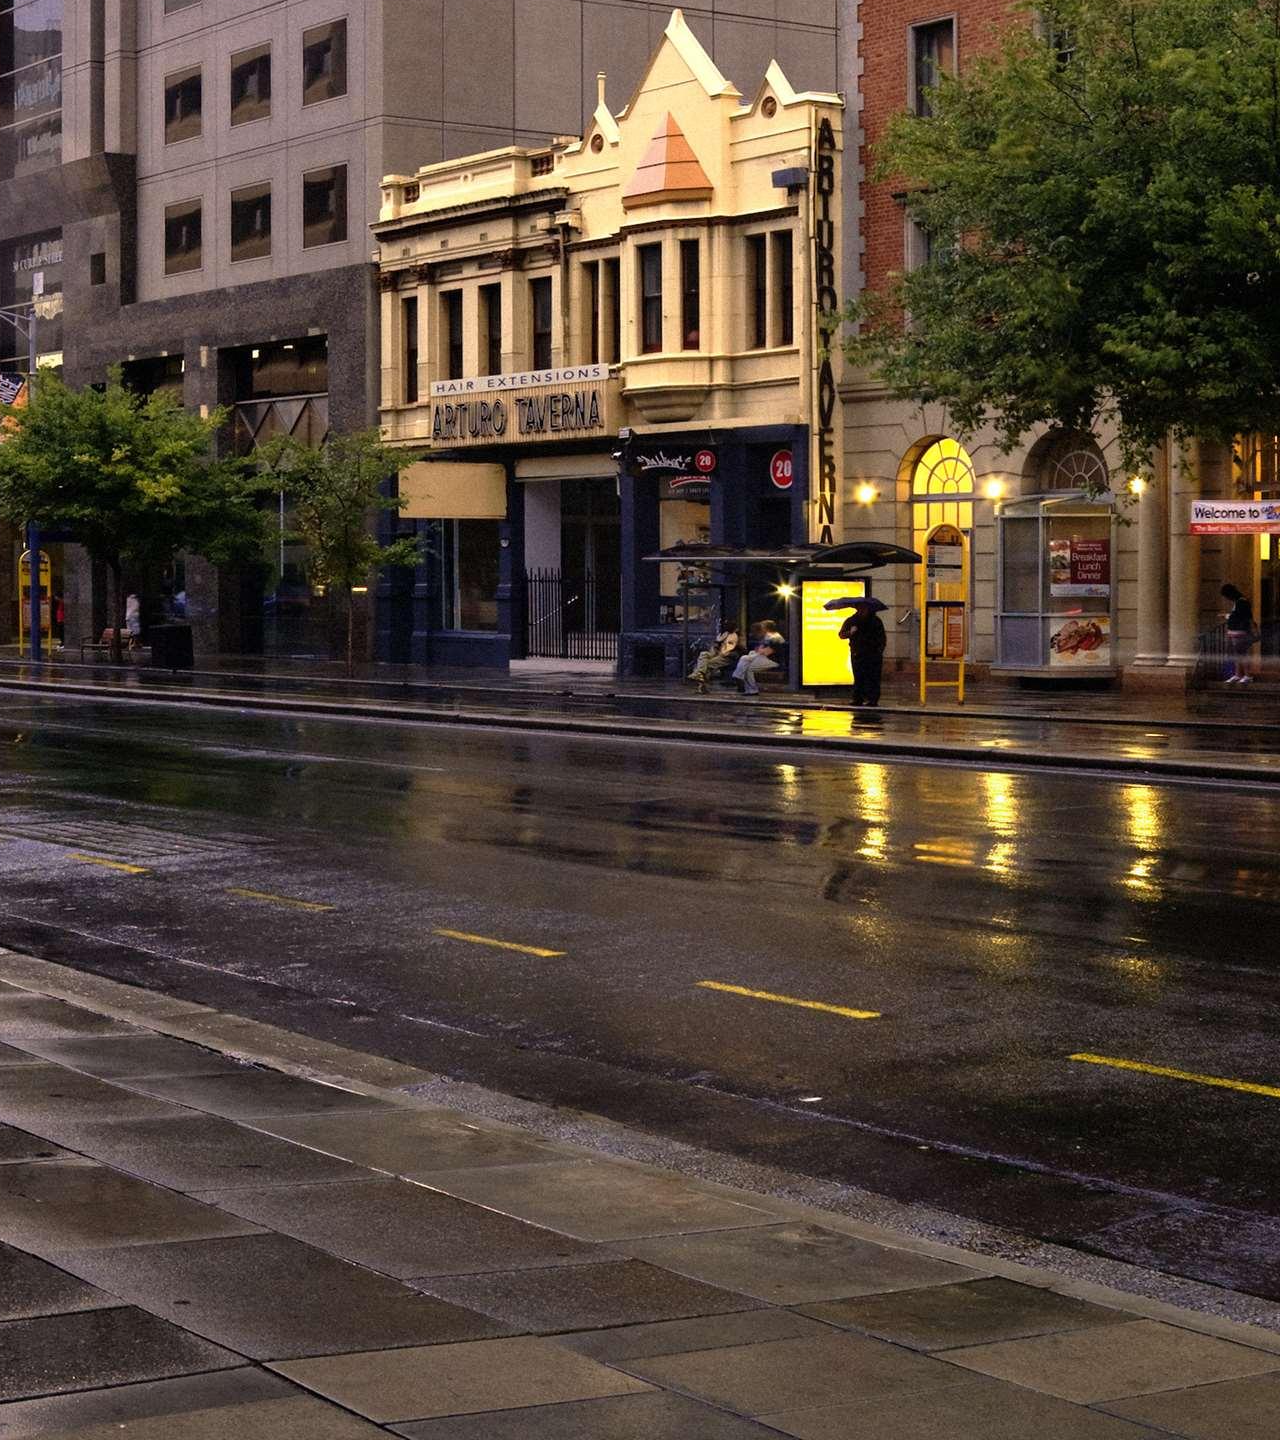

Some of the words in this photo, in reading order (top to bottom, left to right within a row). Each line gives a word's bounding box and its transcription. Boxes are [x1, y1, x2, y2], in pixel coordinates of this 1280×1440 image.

[817, 118, 837, 313] ARTURO
[436, 381, 475, 393] HAIR
[487, 367, 601, 388] EXTENSIONS
[433, 398, 507, 440] ARTURO
[515, 390, 604, 435] TAVERNA
[699, 455, 712, 466] 20
[776, 461, 792, 478] 20
[1195, 507, 1246, 519] Welcome
[1249, 508, 1260, 519] to
[1072, 552, 1107, 561] Breakfast
[1078, 561, 1101, 570] Lunch
[1077, 571, 1101, 580] Dinner
